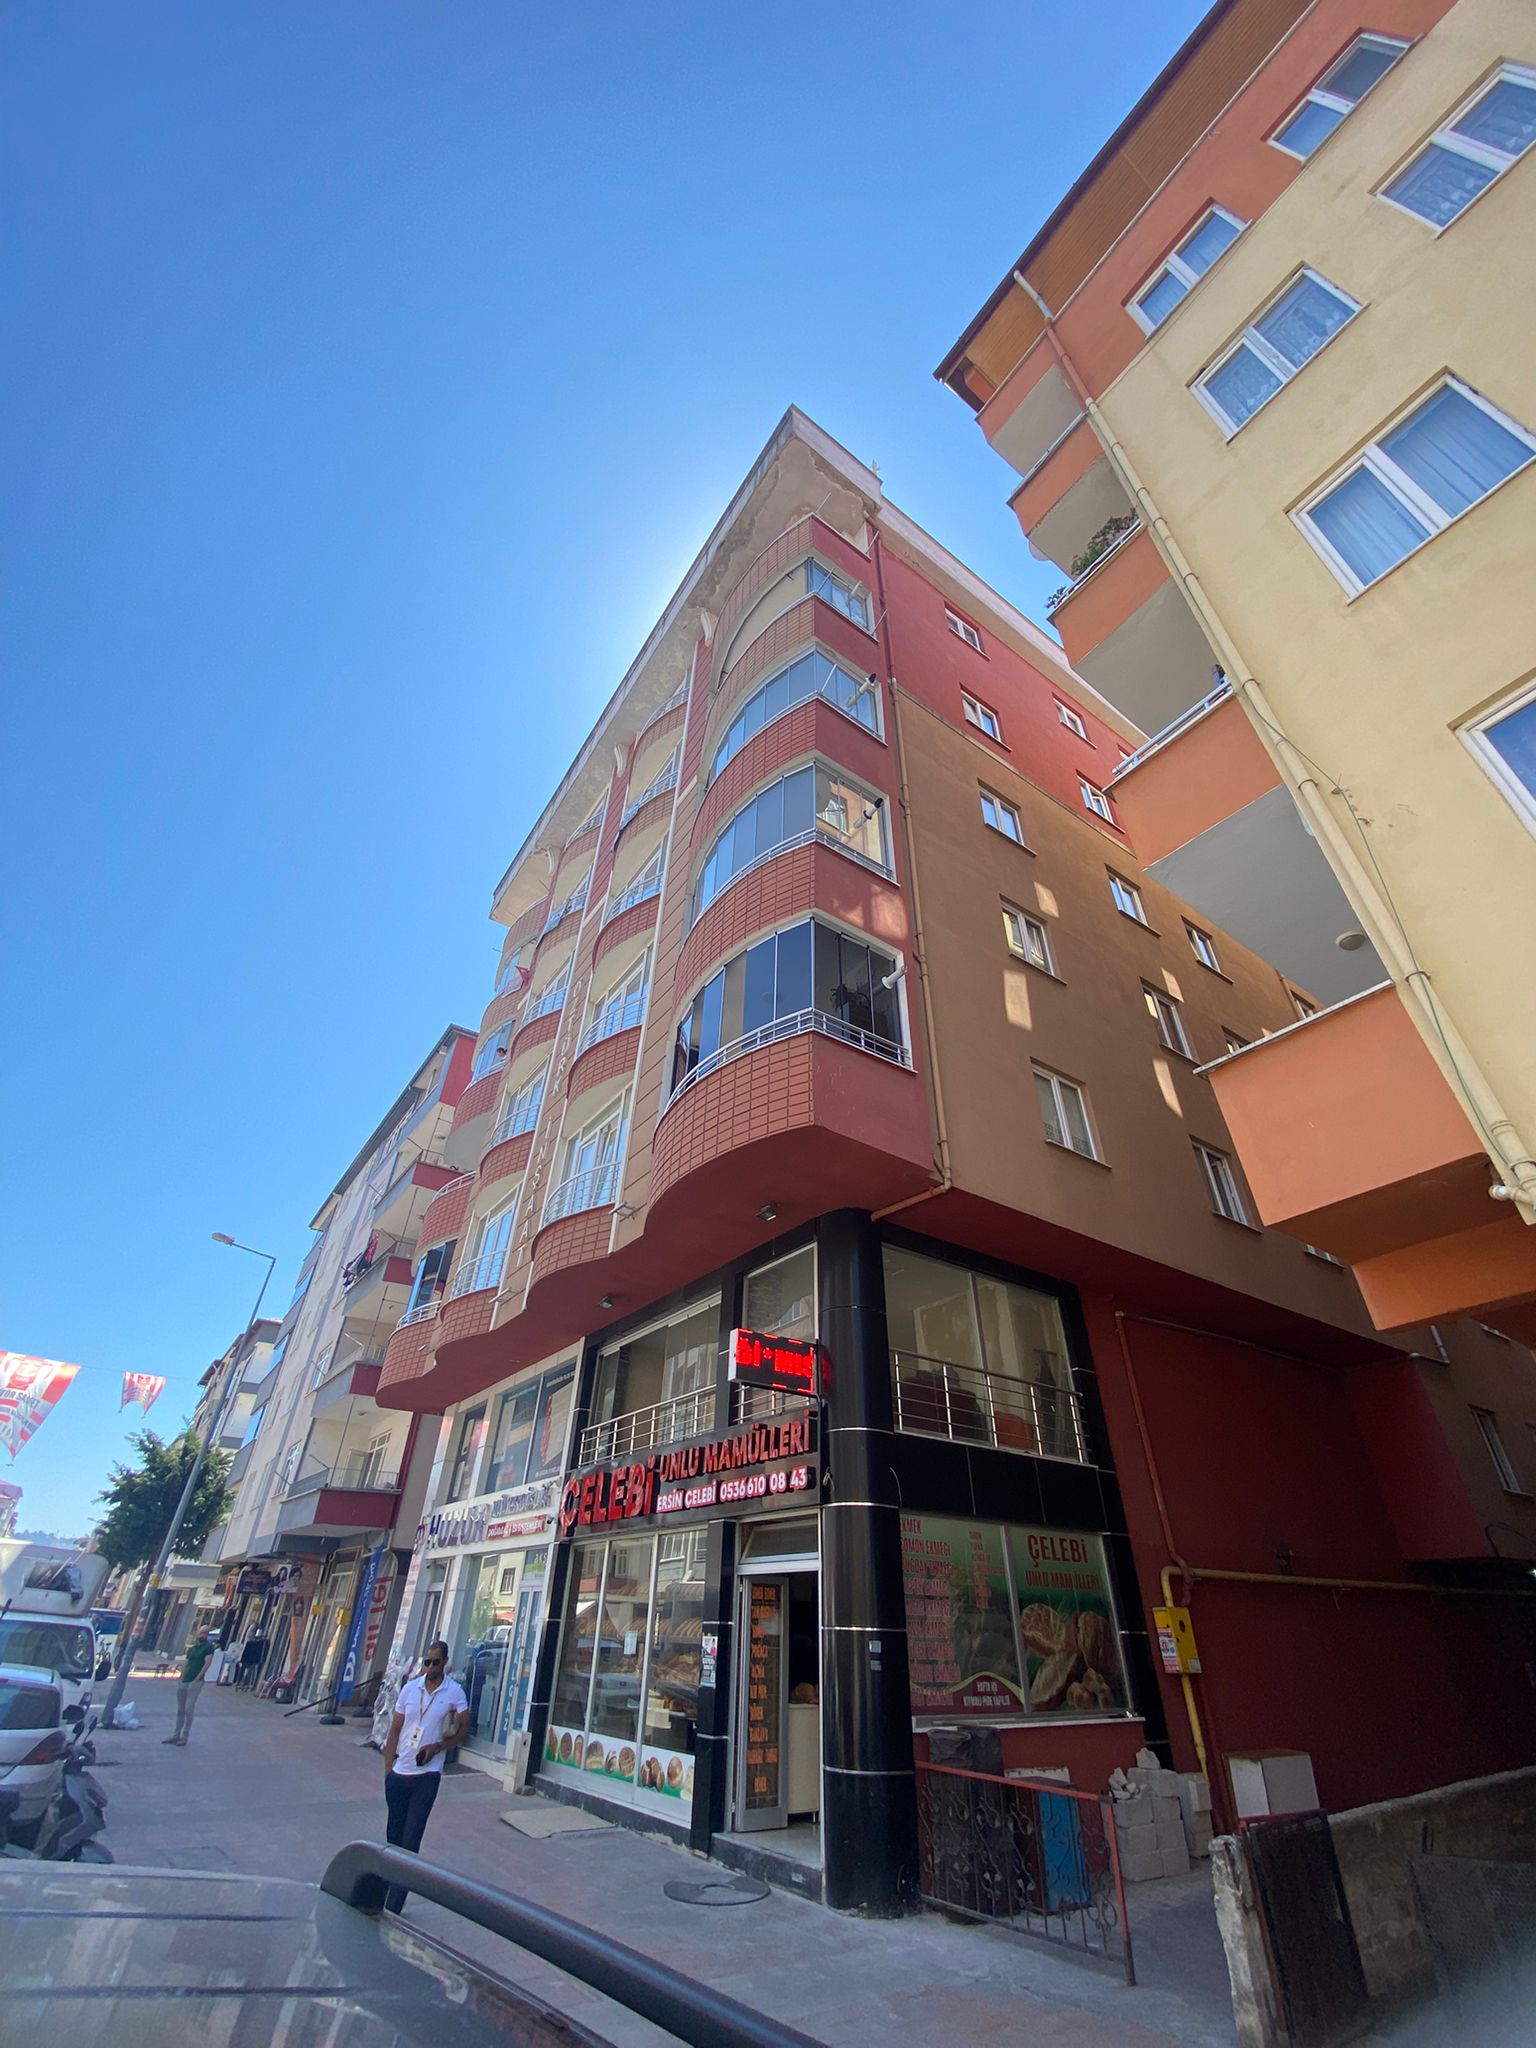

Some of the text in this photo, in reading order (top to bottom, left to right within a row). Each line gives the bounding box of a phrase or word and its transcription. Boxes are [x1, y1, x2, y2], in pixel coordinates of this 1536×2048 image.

[516, 1116, 552, 1268] İNŞAAT
[659, 1408, 811, 1483] UNLU MAMÜLLERİ
[559, 1454, 656, 1537] ÇELEBİ
[656, 1488, 684, 1513] ERSİN
[684, 1481, 716, 1510] ÇELEBİ
[769, 1471, 786, 1493] 08
[790, 1466, 807, 1488] 43
[1025, 1570, 1050, 1588] UNLU
[1026, 1534, 1089, 1568] ÇELEBİ
